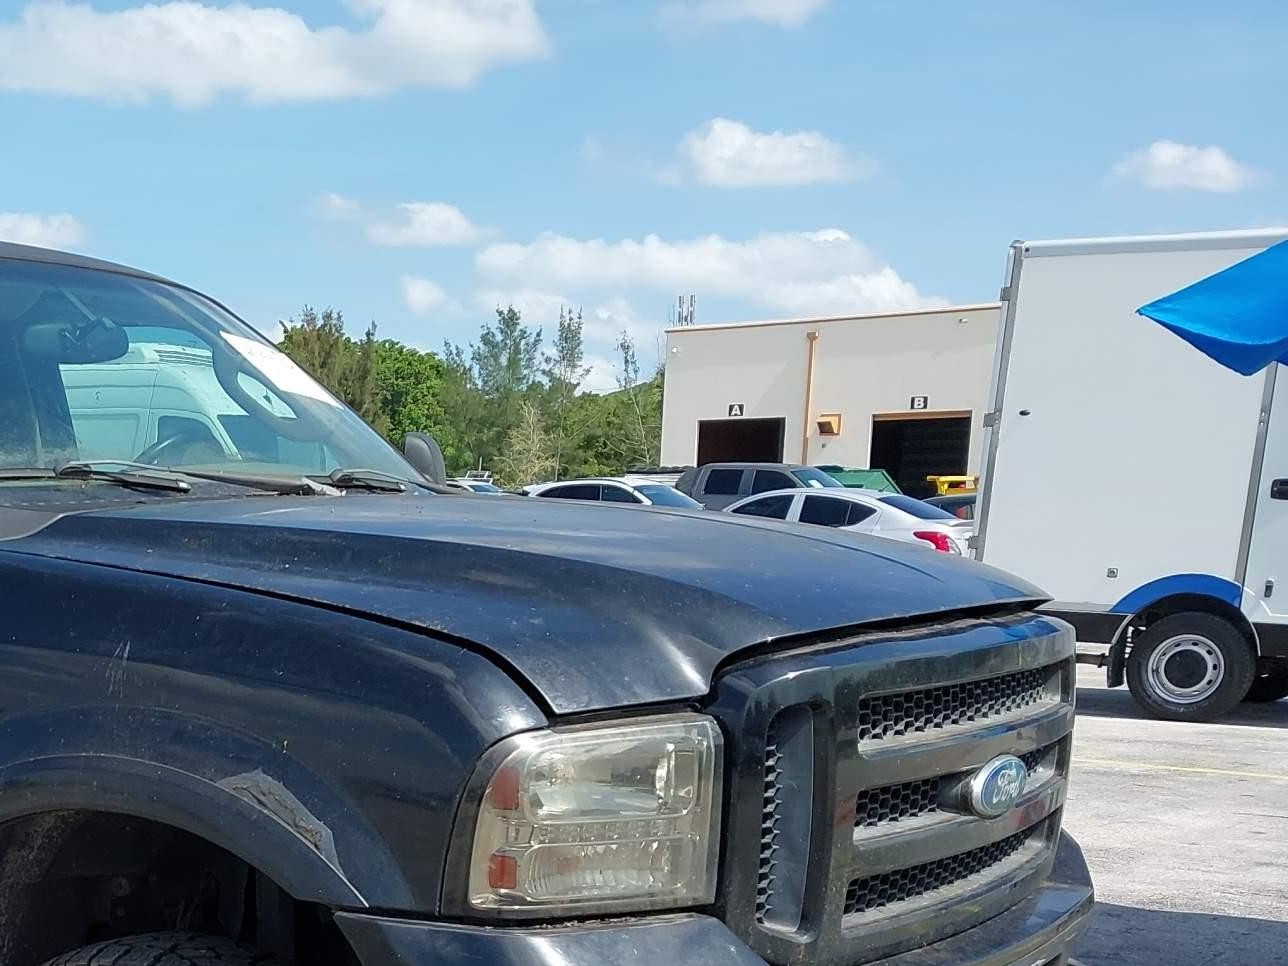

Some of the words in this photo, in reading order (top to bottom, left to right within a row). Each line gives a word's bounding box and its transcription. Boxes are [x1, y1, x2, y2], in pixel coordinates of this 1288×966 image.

[914, 397, 925, 409] B
[730, 405, 742, 416] A
[992, 767, 1023, 805] Ford
